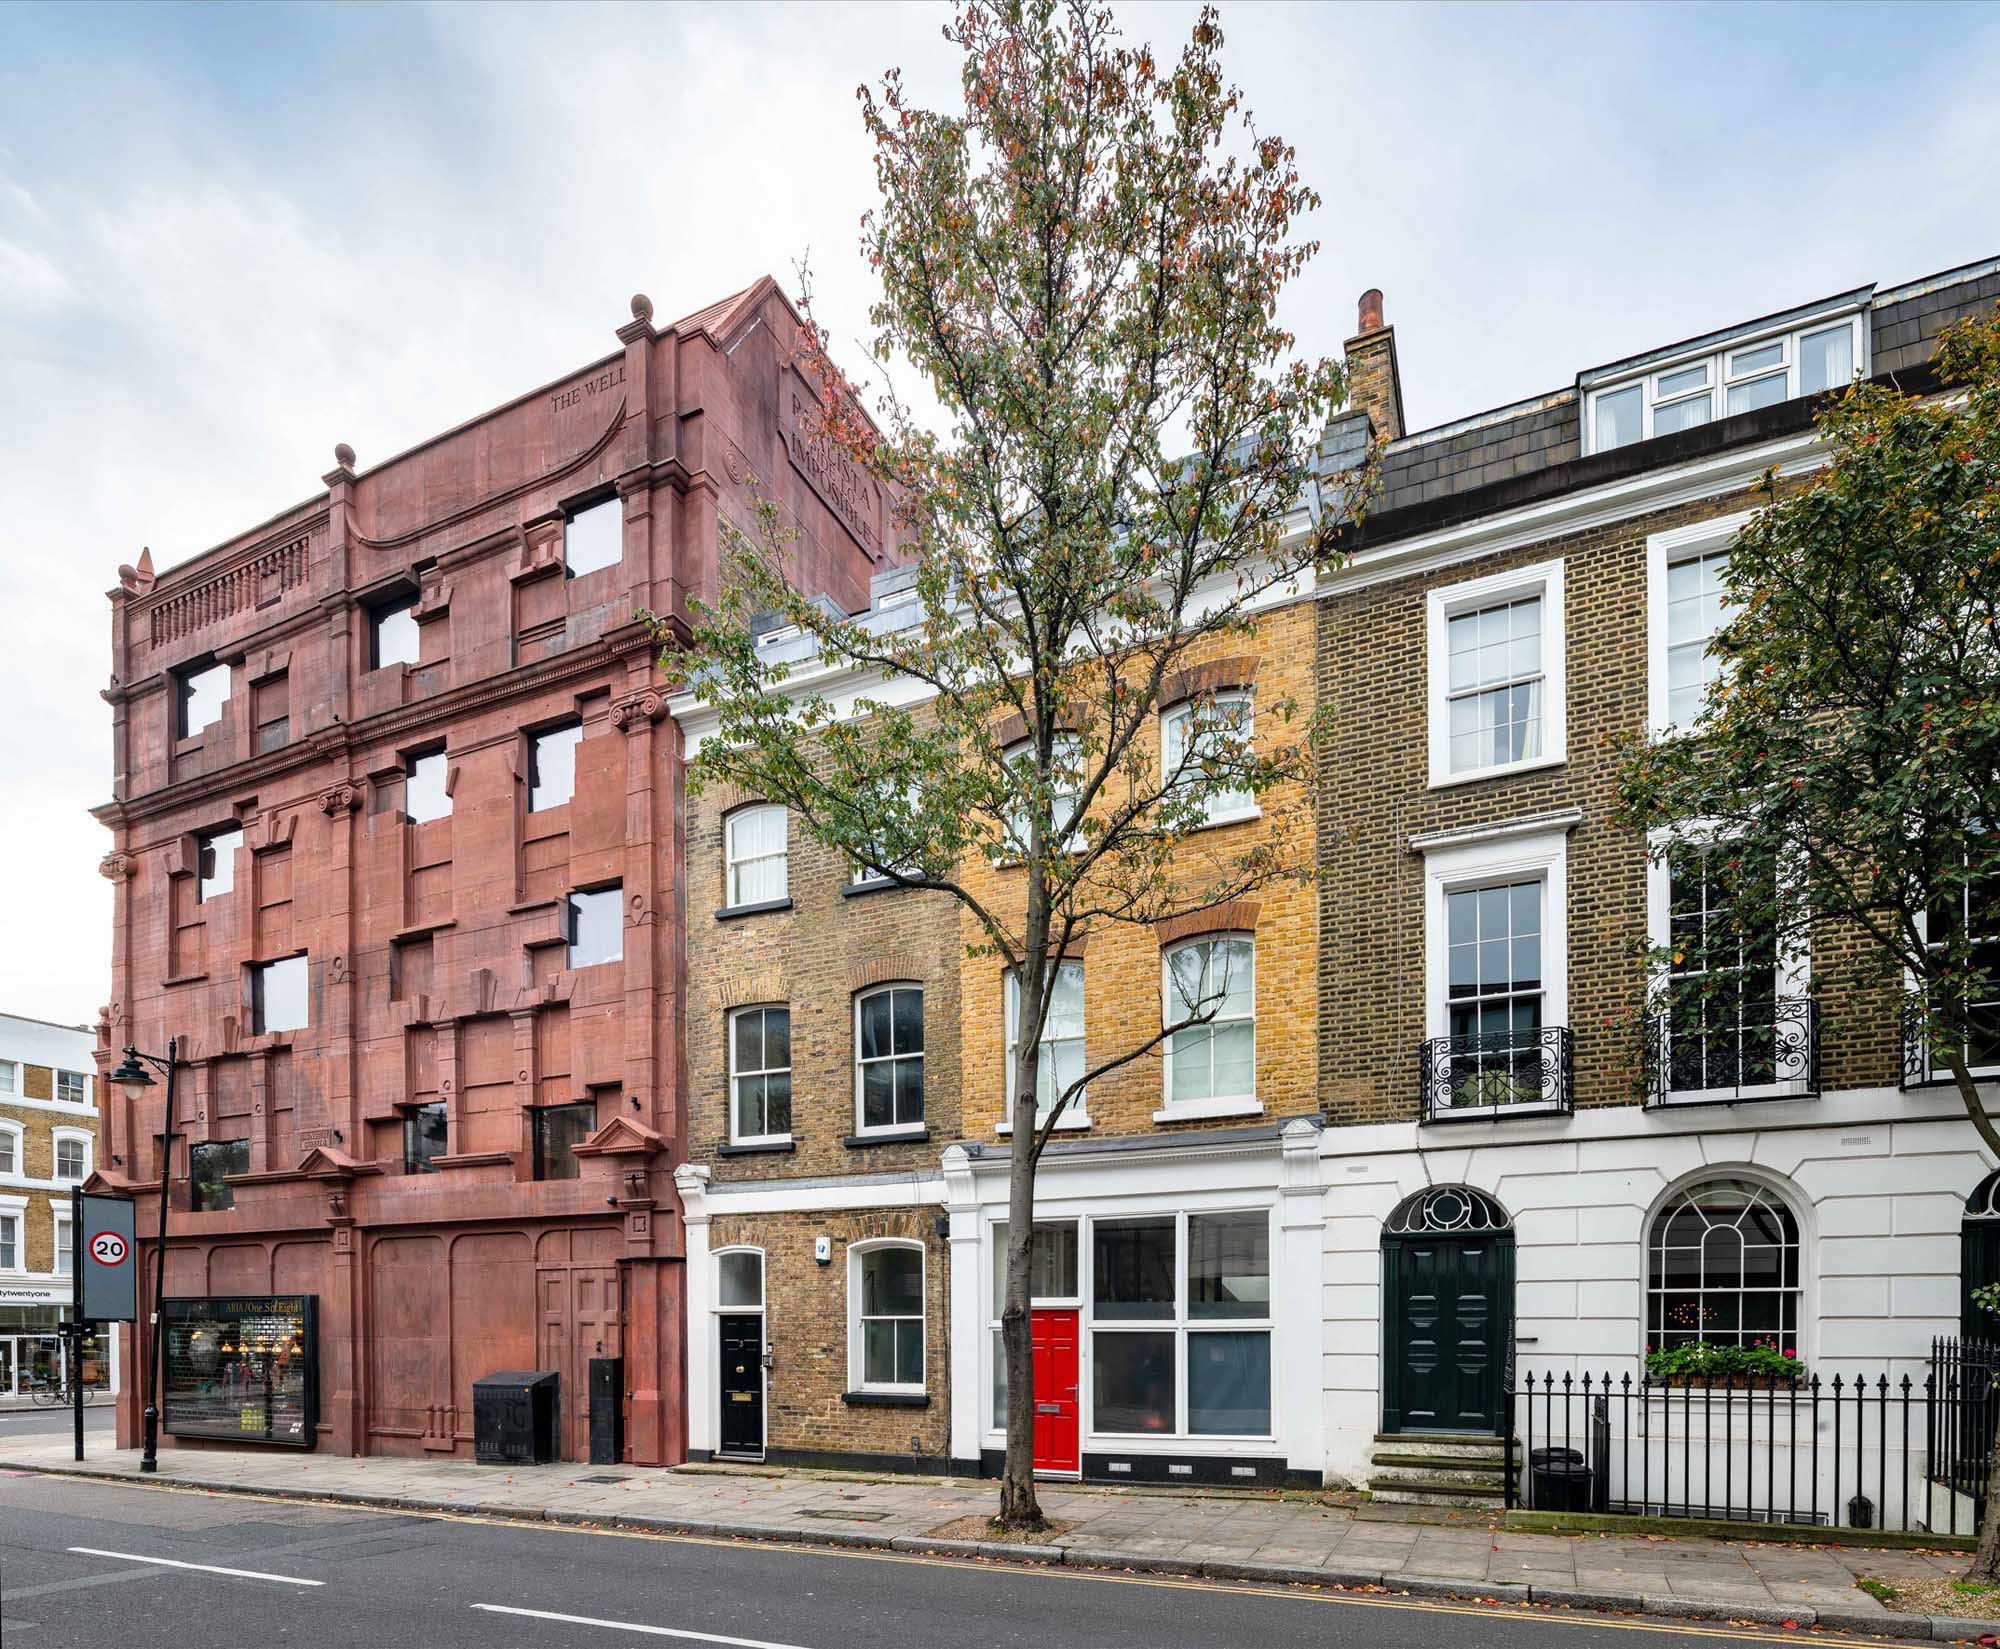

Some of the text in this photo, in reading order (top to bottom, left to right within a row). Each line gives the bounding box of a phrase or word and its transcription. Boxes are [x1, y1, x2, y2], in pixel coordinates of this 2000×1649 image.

[551, 367, 627, 413] THE WELL
[792, 432, 872, 546] IMPOSIBLE
[96, 1241, 123, 1257] 20
